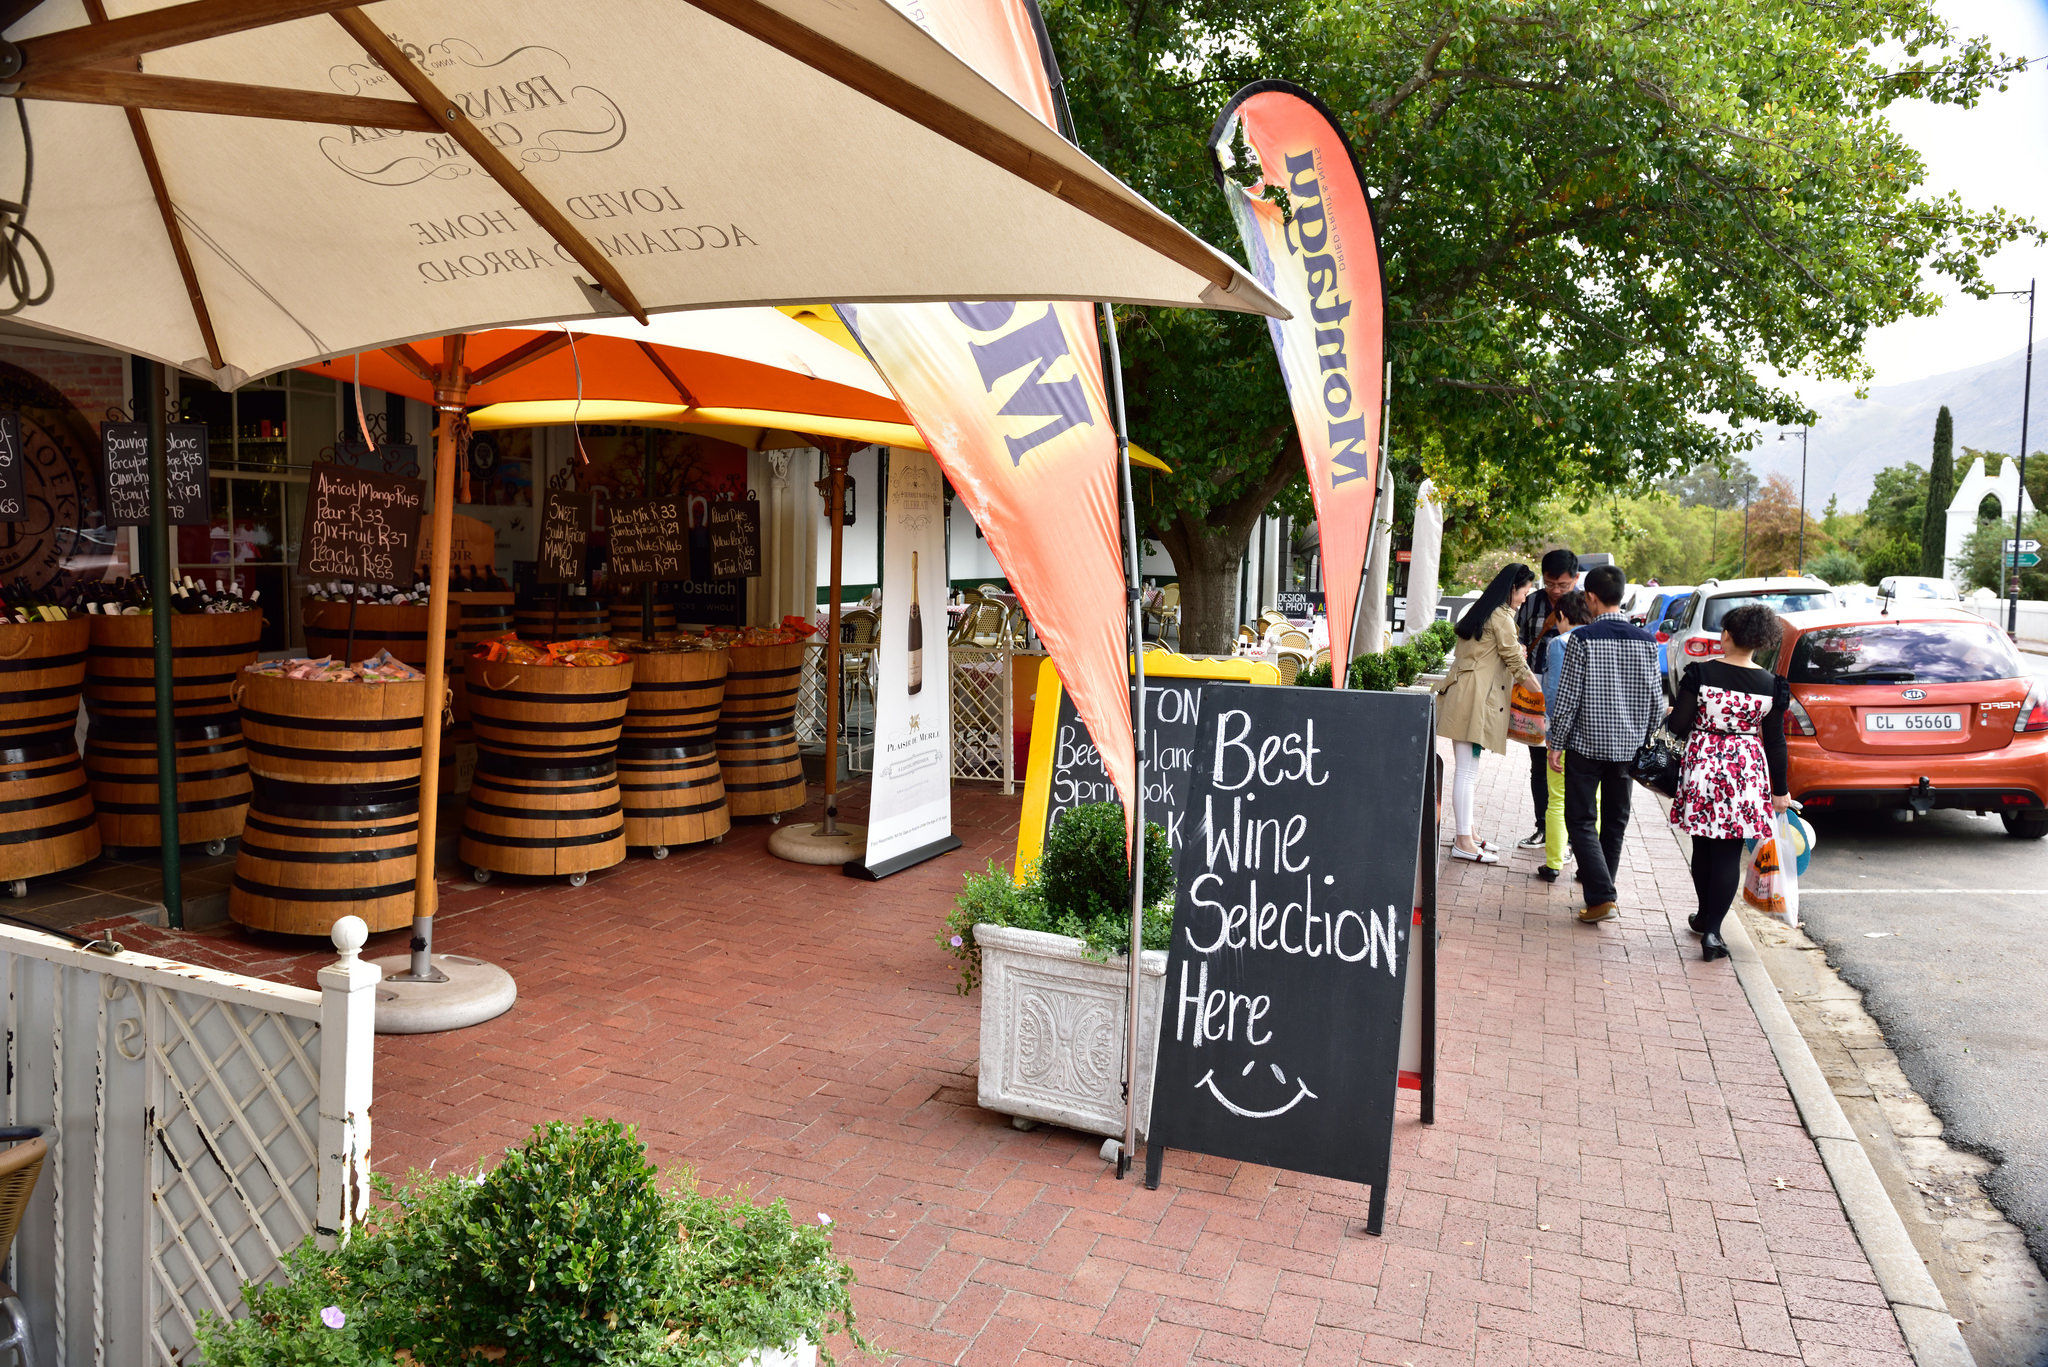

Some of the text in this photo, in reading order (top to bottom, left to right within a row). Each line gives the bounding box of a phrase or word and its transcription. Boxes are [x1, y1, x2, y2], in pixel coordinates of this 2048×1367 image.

[176, 482, 201, 504] R109
[168, 505, 184, 518] 78
[317, 497, 346, 520] Pear
[313, 521, 407, 551] Mix Fruit R37
[658, 519, 680, 537] R29
[311, 537, 393, 570] Peach R55
[611, 538, 635, 555] Pecan
[636, 537, 659, 552] Nuts
[309, 558, 394, 580] Guava R55
[612, 554, 678, 575] Mix Nuts R89
[682, 580, 737, 596] Ostrich
[1278, 593, 1307, 602] DESIGN
[1277, 603, 1284, 611] &
[1904, 690, 1924, 699] KIA
[1876, 715, 1952, 729] CL 65660
[1212, 709, 1329, 791] Best
[1205, 792, 1311, 874] Wine
[1176, 961, 1273, 1047] Here
